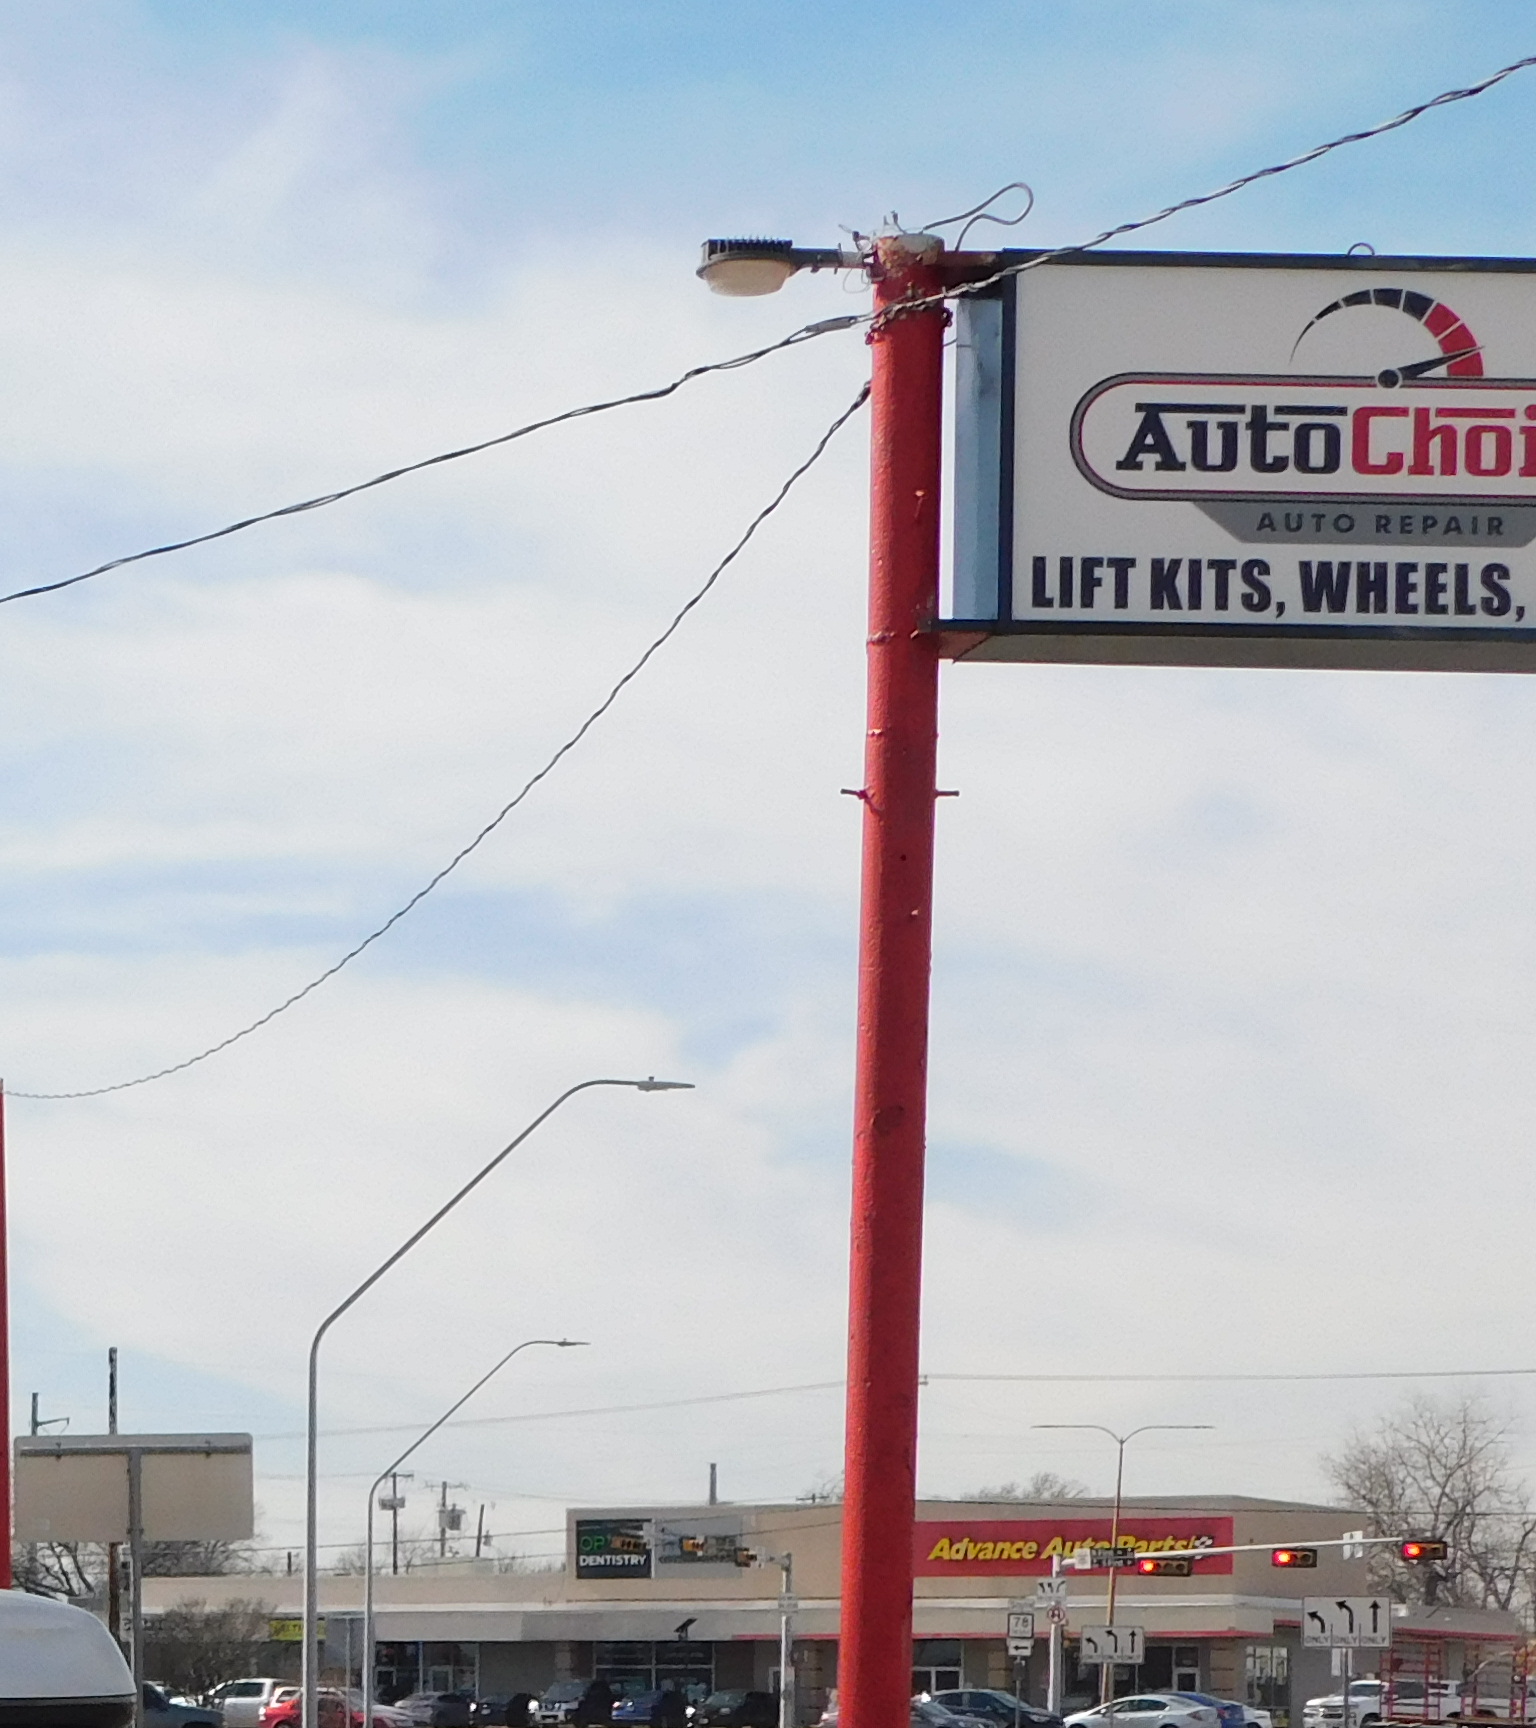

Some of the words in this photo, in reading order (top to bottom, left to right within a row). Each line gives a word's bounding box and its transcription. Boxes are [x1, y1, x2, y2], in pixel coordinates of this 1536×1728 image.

[1256, 512, 1356, 535] AUTO
[1374, 514, 1506, 537] REPAIR
[1031, 555, 1136, 610] LIFT
[1150, 557, 1286, 619] KITS,
[1298, 560, 1526, 622] WHEELS,
[579, 1554, 647, 1567] DENTISTRY
[929, 1537, 1038, 1561] Advance
[1014, 1616, 1029, 1628] 78
